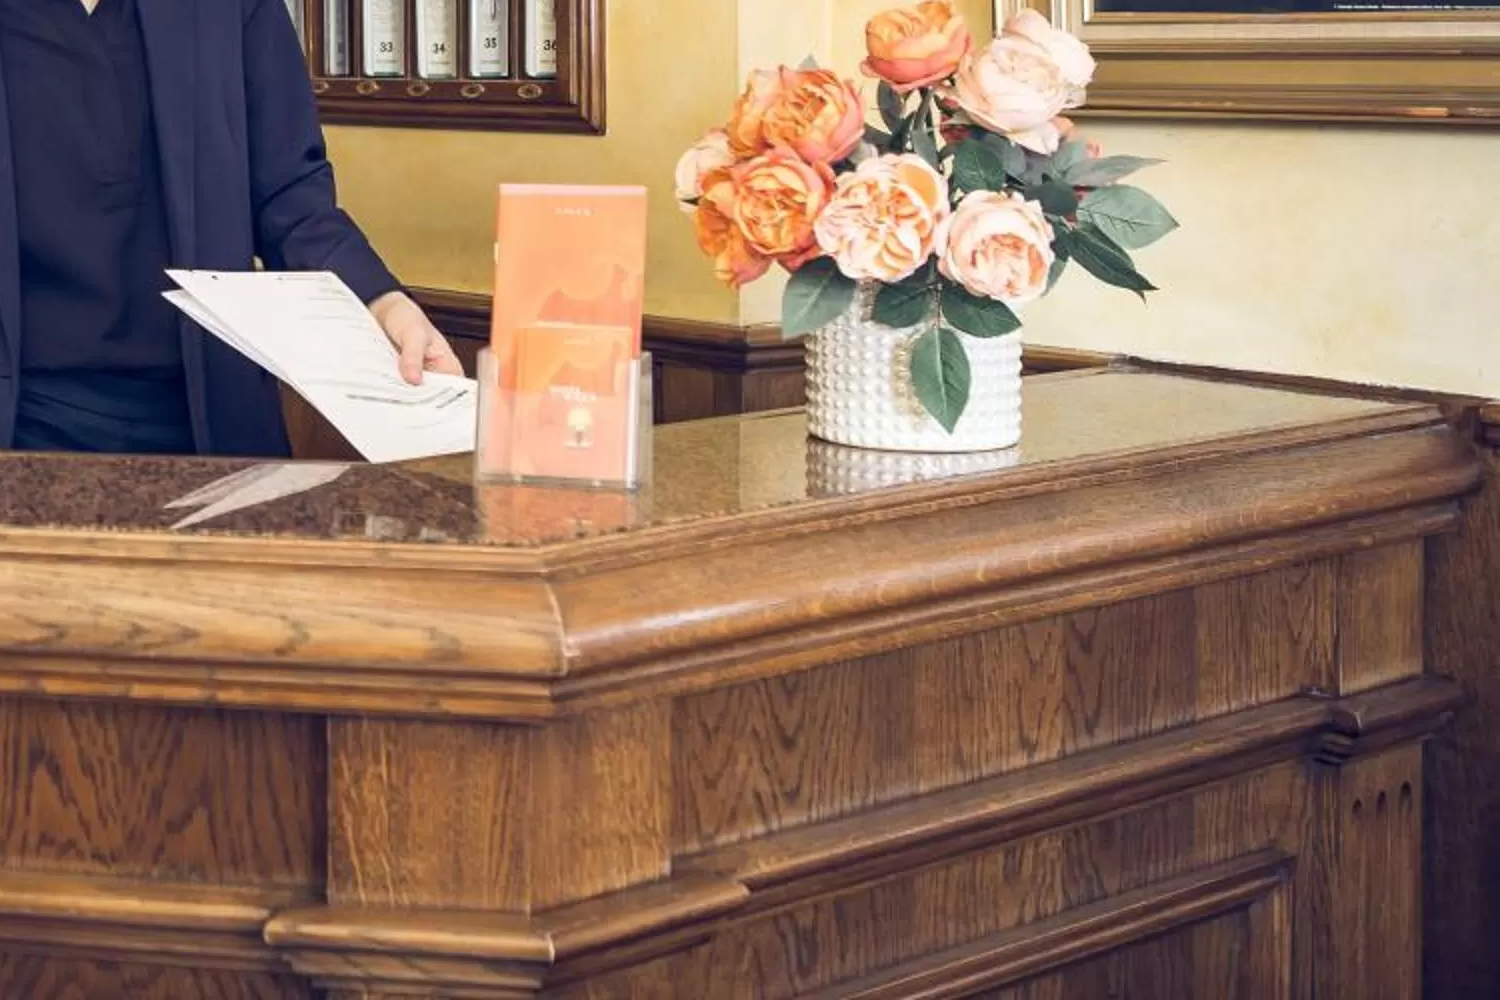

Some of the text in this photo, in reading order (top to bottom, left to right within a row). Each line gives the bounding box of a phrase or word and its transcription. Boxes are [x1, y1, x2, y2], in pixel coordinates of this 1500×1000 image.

[379, 41, 394, 54] 33
[432, 42, 446, 55] 34
[483, 37, 498, 50] 35
